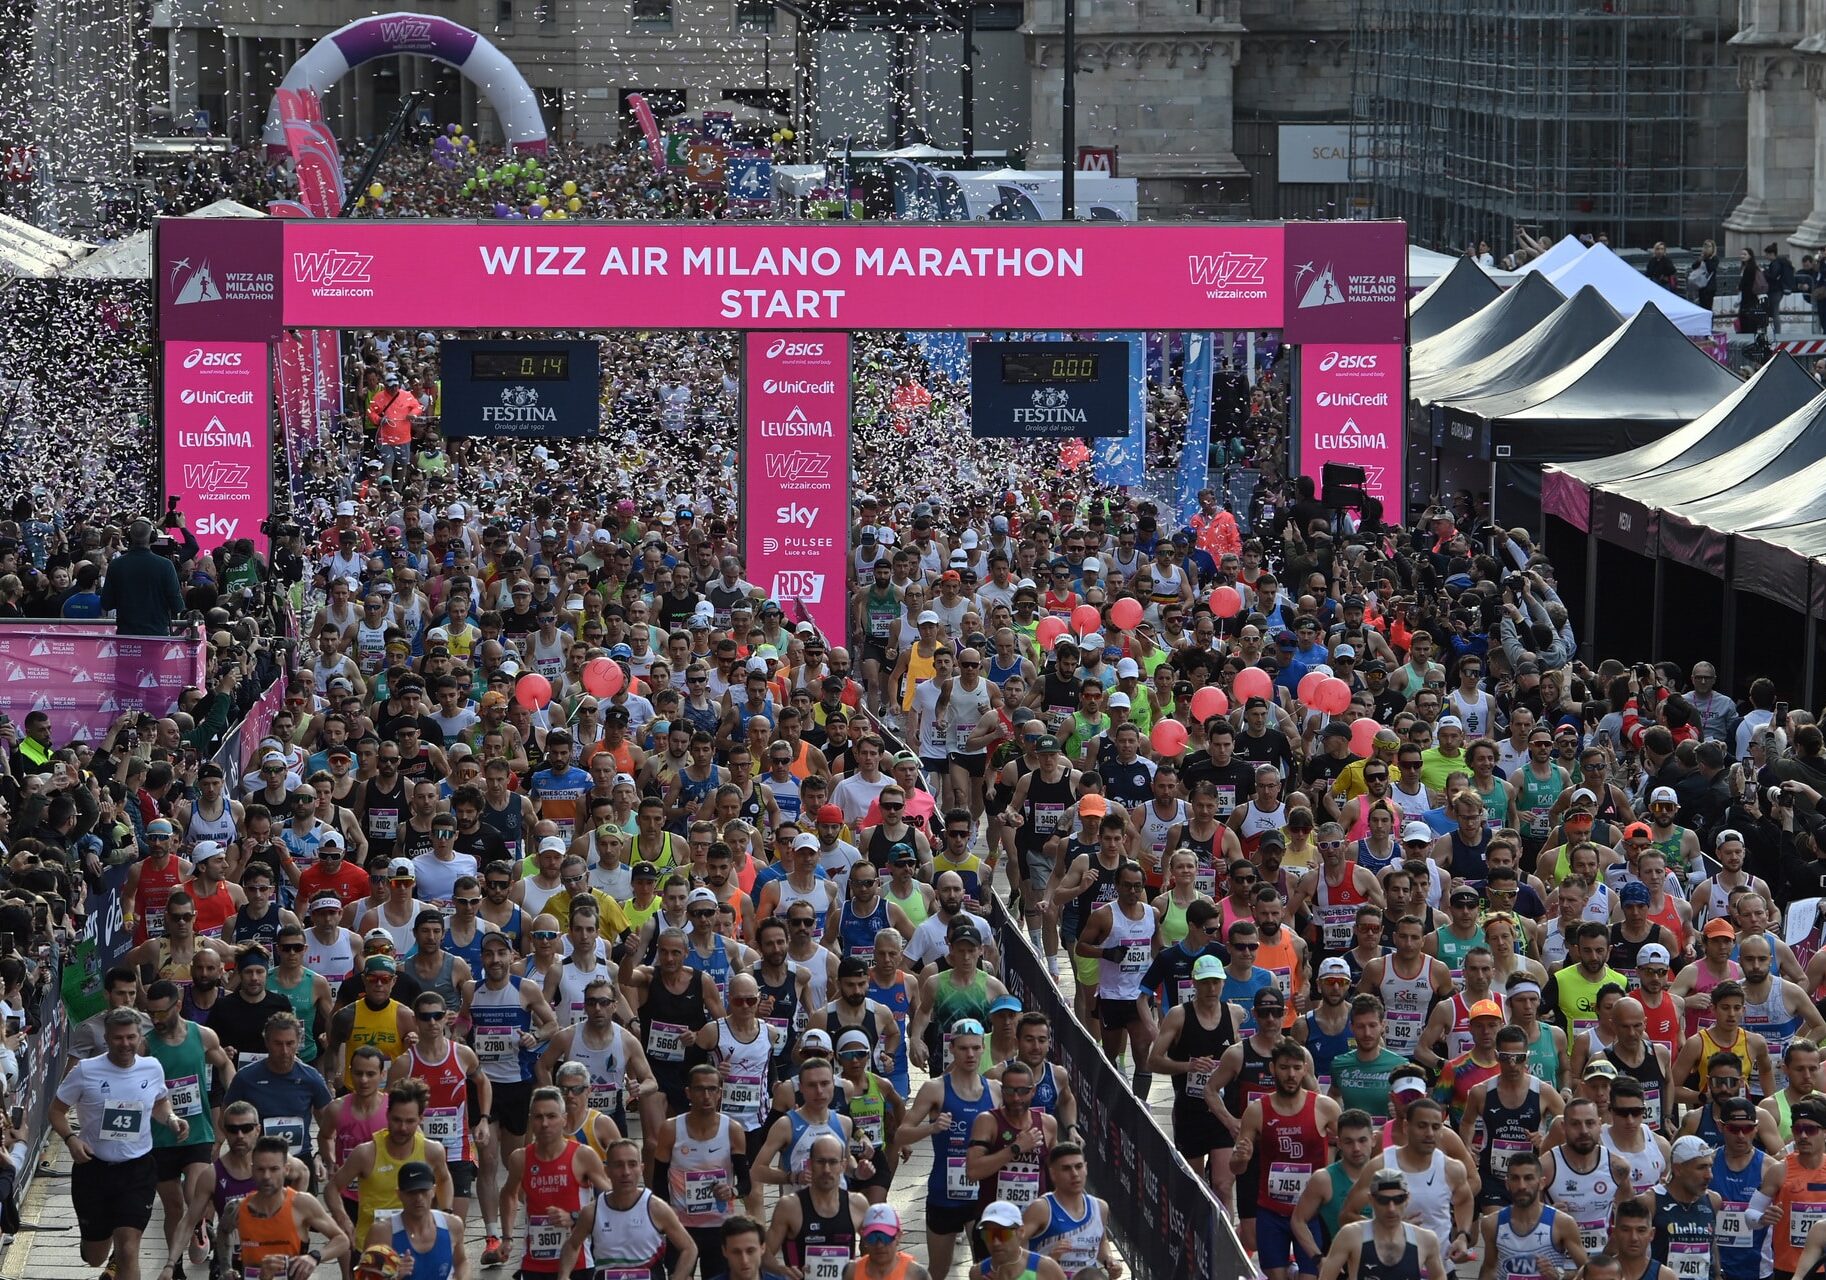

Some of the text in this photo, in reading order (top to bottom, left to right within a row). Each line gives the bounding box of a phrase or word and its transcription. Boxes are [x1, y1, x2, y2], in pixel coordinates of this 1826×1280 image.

[740, 165, 760, 191] 4
[293, 249, 374, 286] WIZZ
[479, 245, 1084, 277] WIZZ AIR MILANO MARATHON
[225, 272, 273, 281] WIZZ AIR
[1188, 251, 1268, 289] WIZZ
[1348, 275, 1396, 284] WIZZ AIR
[225, 282, 274, 292] MILANO
[312, 287, 373, 297] wizzair.com
[1348, 285, 1397, 294] MILANO
[1206, 289, 1267, 299] wizzair.com
[719, 288, 845, 319] START
[779, 380, 835, 394] UniCredit
[196, 390, 254, 404] UniCredit
[1332, 392, 1388, 406] UniCredit
[482, 407, 558, 422] FESTINA
[1012, 408, 1088, 423] FESTINA
[494, 423, 518, 432] Orologi
[530, 424, 545, 432] 1902
[761, 420, 833, 438] LEVISSIMA
[1025, 424, 1049, 432] Orologi
[1049, 424, 1060, 432] dal
[179, 431, 252, 448] LEVISSIMA
[1314, 432, 1387, 450] LEVISSIMA
[765, 449, 832, 481] WIZZ
[183, 460, 250, 492] WIZZ
[780, 482, 831, 490] wizzair.com
[198, 493, 250, 501] wizzair.com
[776, 502, 819, 529] sky
[195, 513, 239, 540] sky
[784, 538, 833, 547] PULSEE
[778, 572, 814, 596] RDS
[375, 820, 391, 830] 4102
[1395, 1026, 1411, 1037] 642
[484, 1041, 504, 1052] 2780
[656, 1039, 678, 1050] 5668
[172, 1092, 192, 1105] 5186
[730, 1090, 751, 1102] 4994
[587, 1098, 609, 1108] 5520
[112, 1115, 132, 1129] 43
[429, 1123, 448, 1135] 1926
[531, 1173, 568, 1189] GOLDEN
[1279, 1180, 1301, 1192] 7454
[1006, 1189, 1030, 1201] 3629
[1723, 1219, 1740, 1232] 479
[538, 1233, 562, 1246] 3607
[817, 1264, 839, 1278] 2178
[1680, 1261, 1700, 1274] 7461
